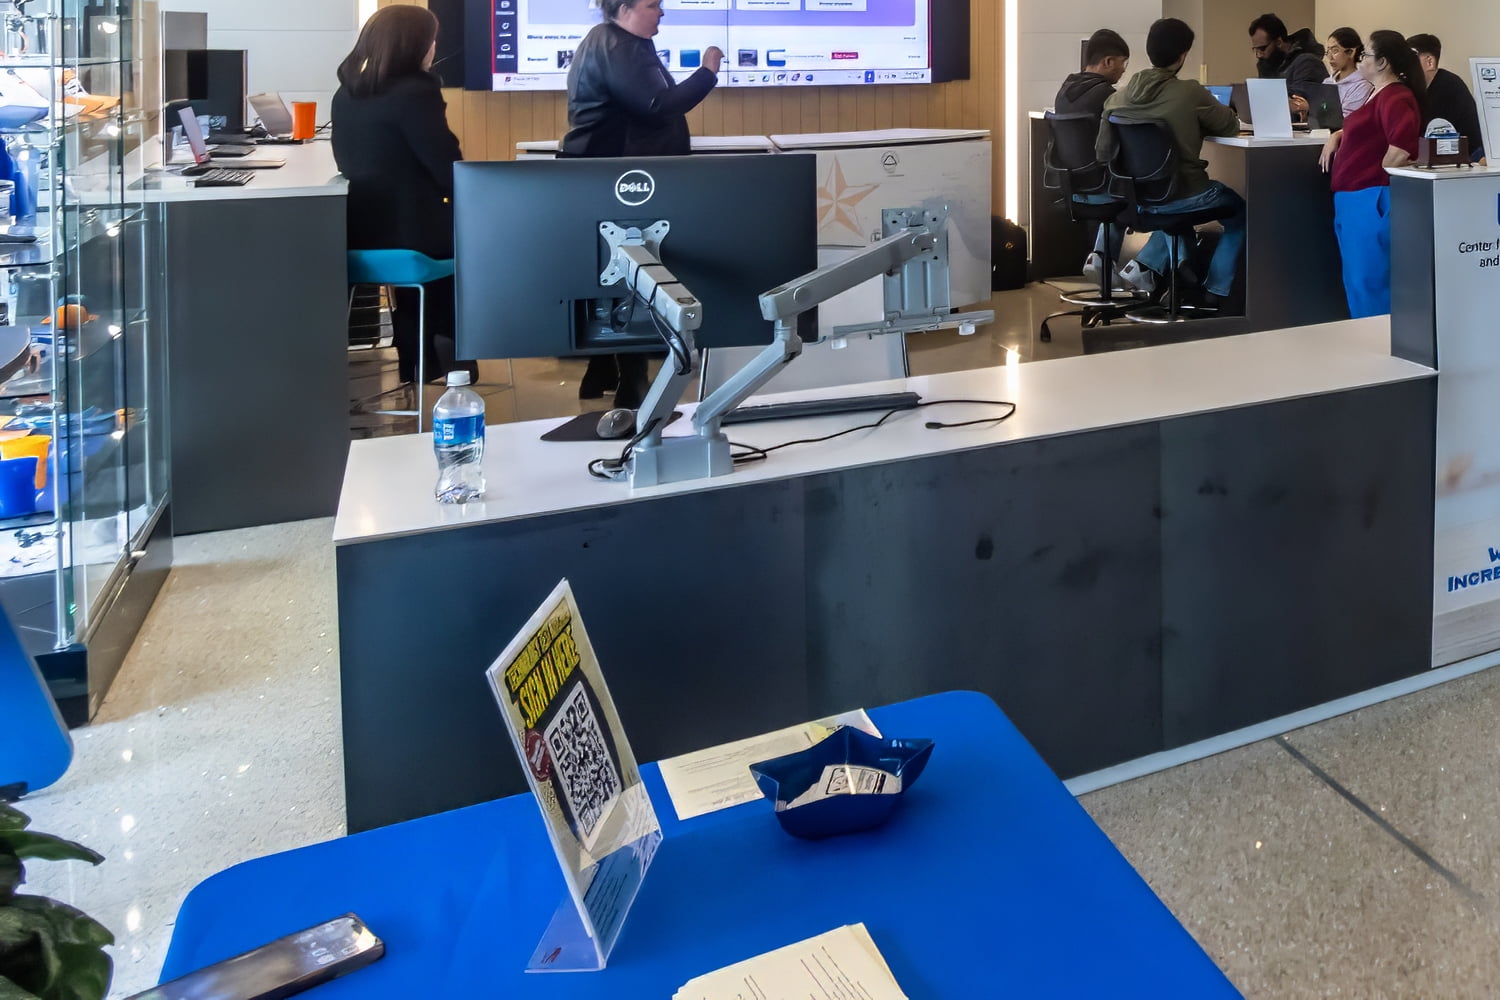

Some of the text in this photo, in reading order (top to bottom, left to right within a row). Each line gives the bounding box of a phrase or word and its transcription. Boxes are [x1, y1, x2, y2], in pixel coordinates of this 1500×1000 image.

[619, 182, 651, 193] DELL
[1458, 241, 1492, 254] Center
[1480, 255, 1500, 267] and
[519, 664, 548, 729] SIGN
